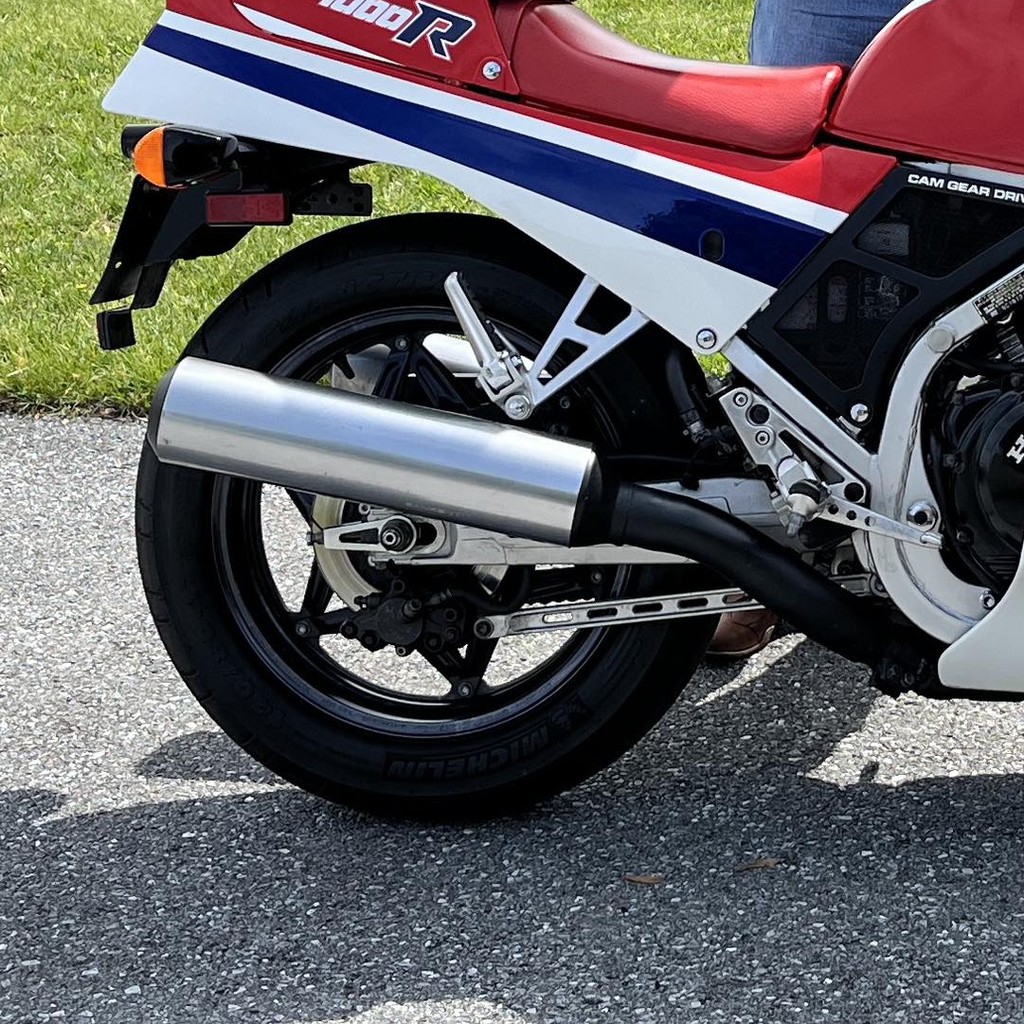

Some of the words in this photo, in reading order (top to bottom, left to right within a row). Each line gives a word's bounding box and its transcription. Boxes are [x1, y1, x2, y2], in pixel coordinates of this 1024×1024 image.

[907, 173, 945, 189] CAM
[946, 180, 991, 197] GEAR
[388, 724, 550, 777] MICHELIN
